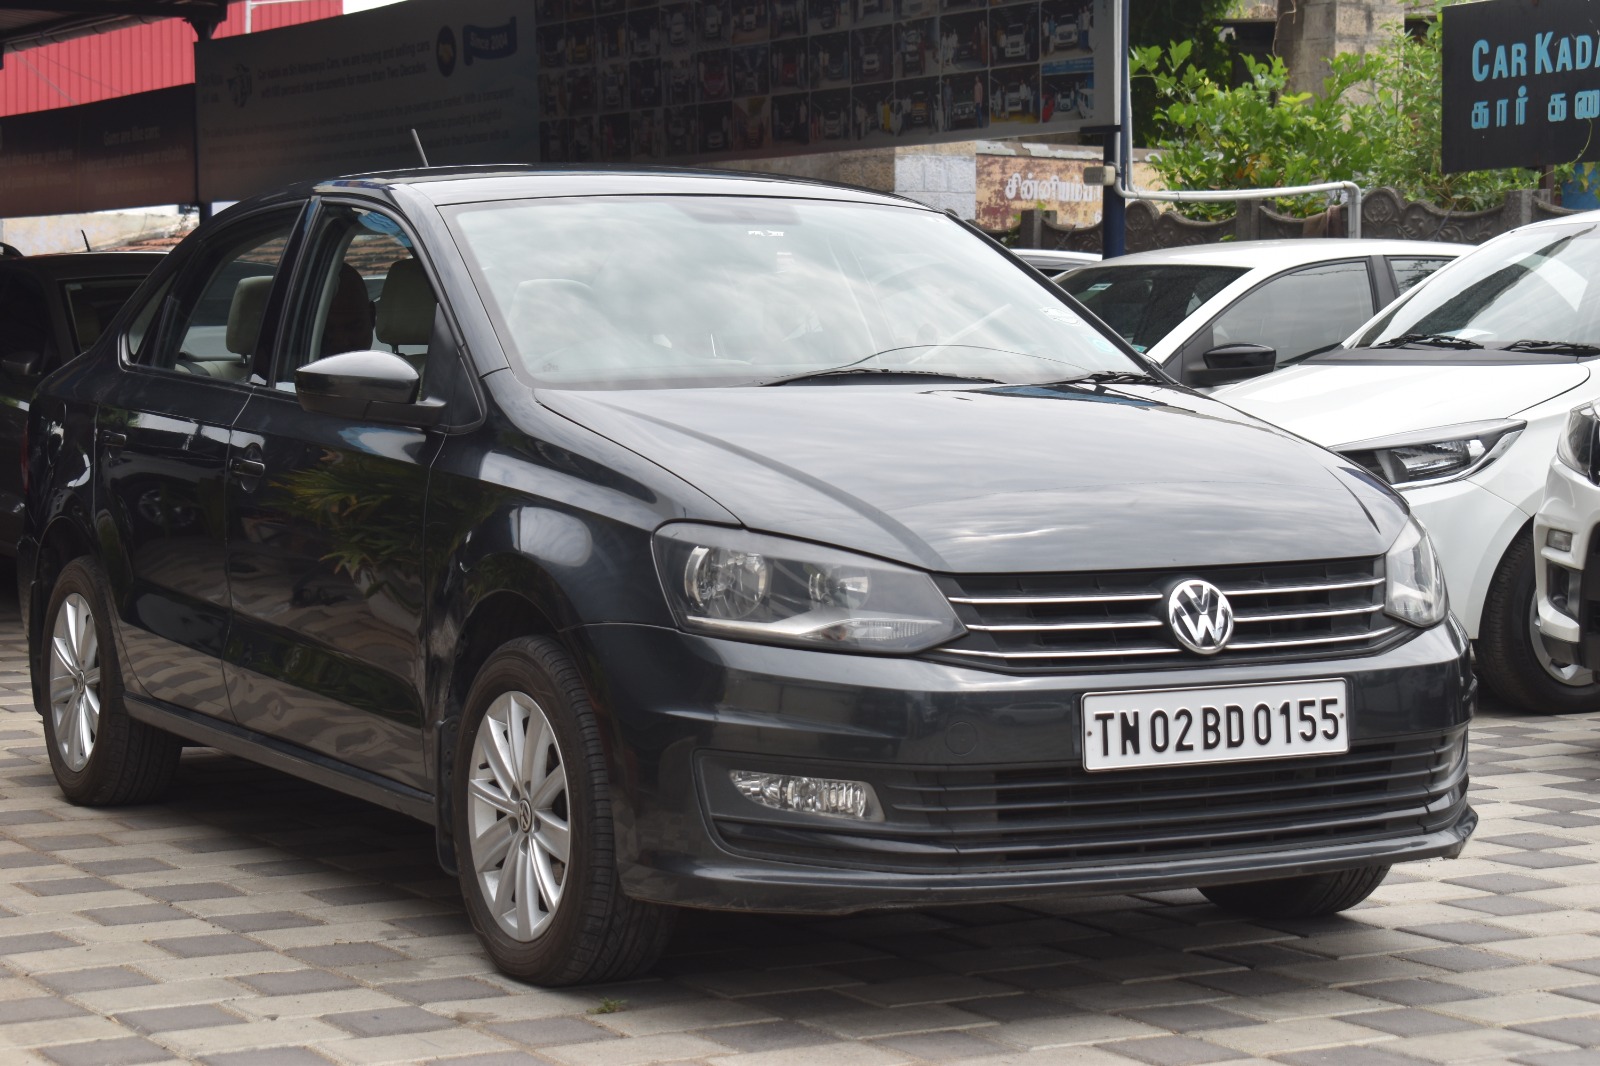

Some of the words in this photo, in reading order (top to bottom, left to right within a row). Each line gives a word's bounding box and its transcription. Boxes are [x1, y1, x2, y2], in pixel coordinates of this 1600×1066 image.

[382, 47, 394, 60] and
[416, 40, 430, 53] cars
[469, 31, 490, 50] Since
[1471, 39, 1528, 82] CAR
[1471, 85, 1529, 129] கார்
